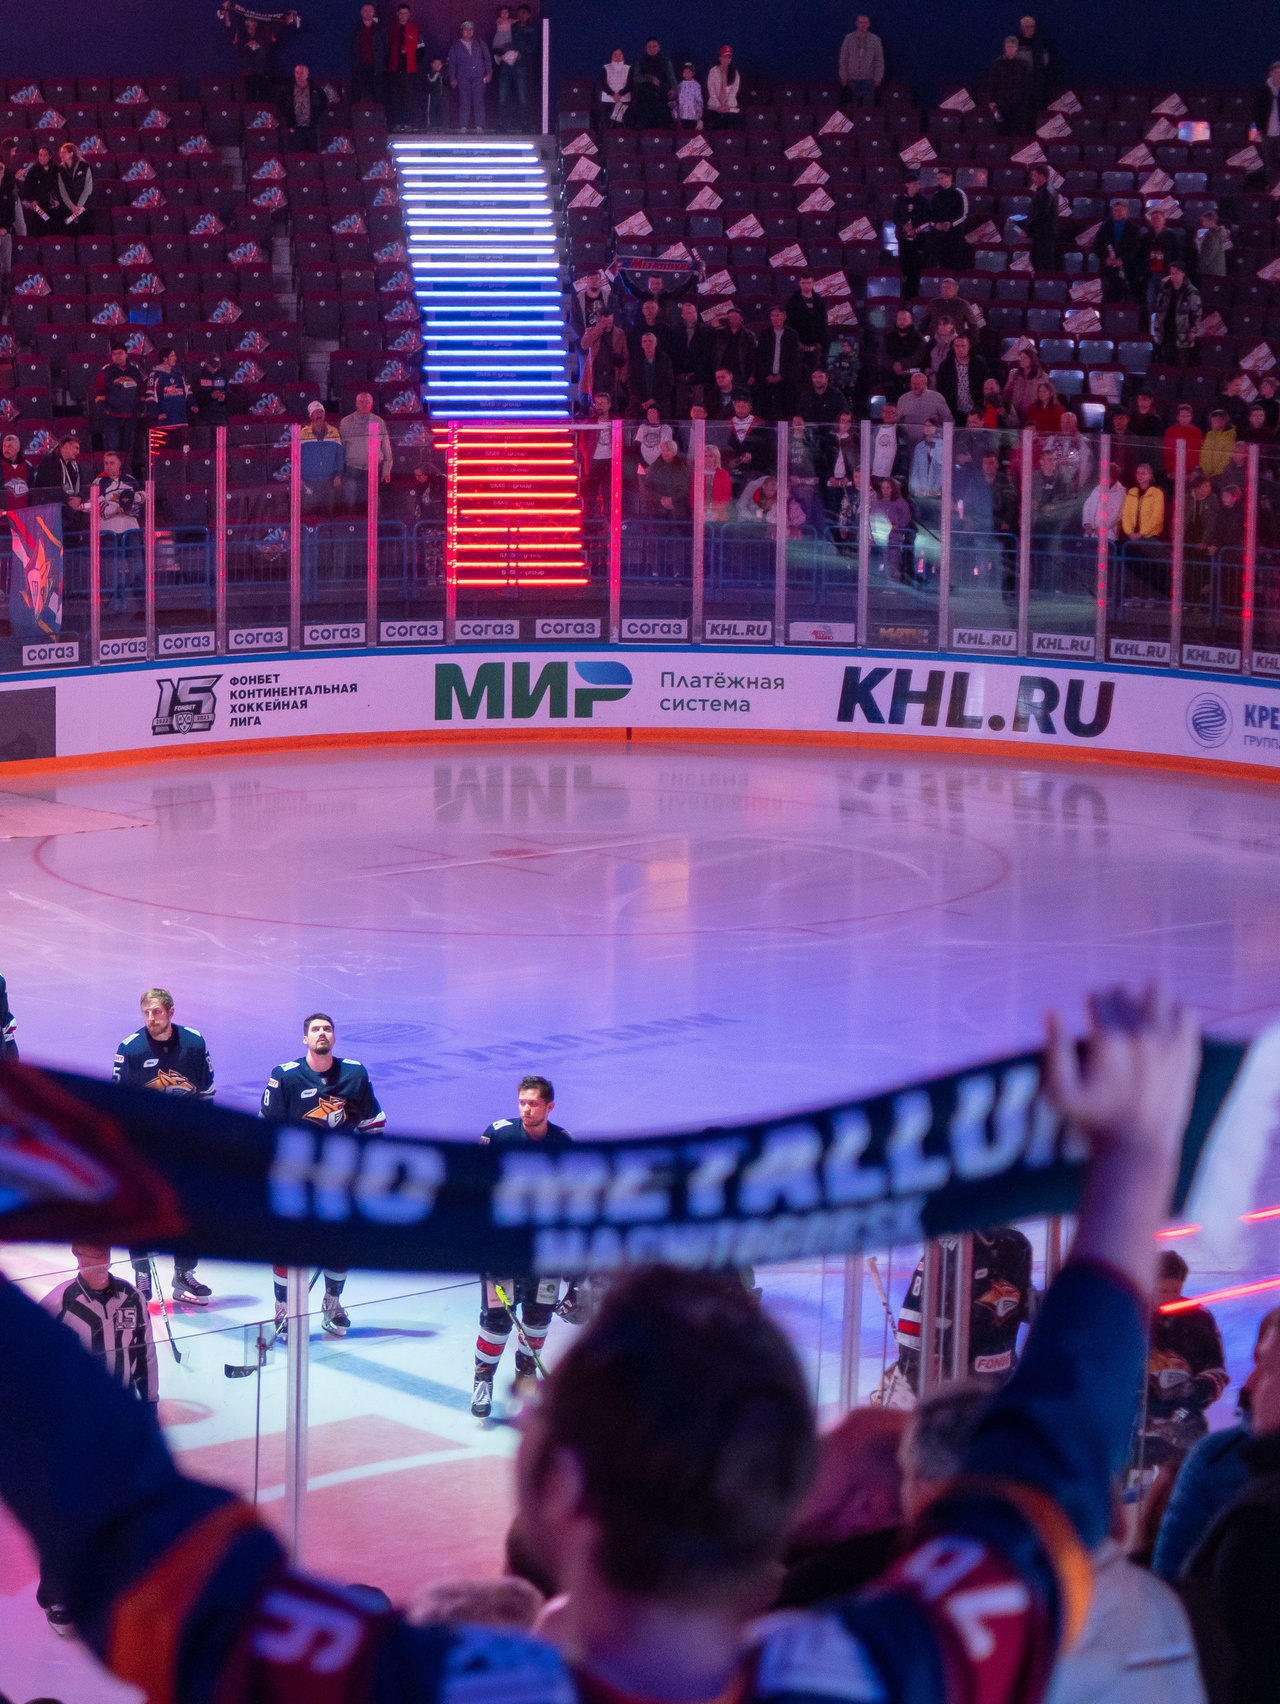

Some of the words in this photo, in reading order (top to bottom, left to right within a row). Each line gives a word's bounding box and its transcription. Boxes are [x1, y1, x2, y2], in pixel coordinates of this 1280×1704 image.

[708, 623, 767, 637] KHL.RU
[957, 632, 1013, 647] KHL.RU
[1036, 636, 1090, 652] KHL.RU
[1115, 640, 1166, 658] KHL.RU
[1186, 648, 1236, 665] KHL.RU
[229, 674, 280, 686] ФОНБЕТ
[660, 671, 785, 691] Платёжная
[230, 683, 358, 700] КОНТИНЕНТАЛЬНАЯ
[434, 661, 632, 720] МИР
[230, 699, 308, 713] ХОККЕЙНАЯ
[660, 697, 751, 713] система
[837, 666, 1115, 738] KHL.RU
[230, 716, 262, 727] ЛИГА
[493, 1062, 1092, 1228] METALLU
